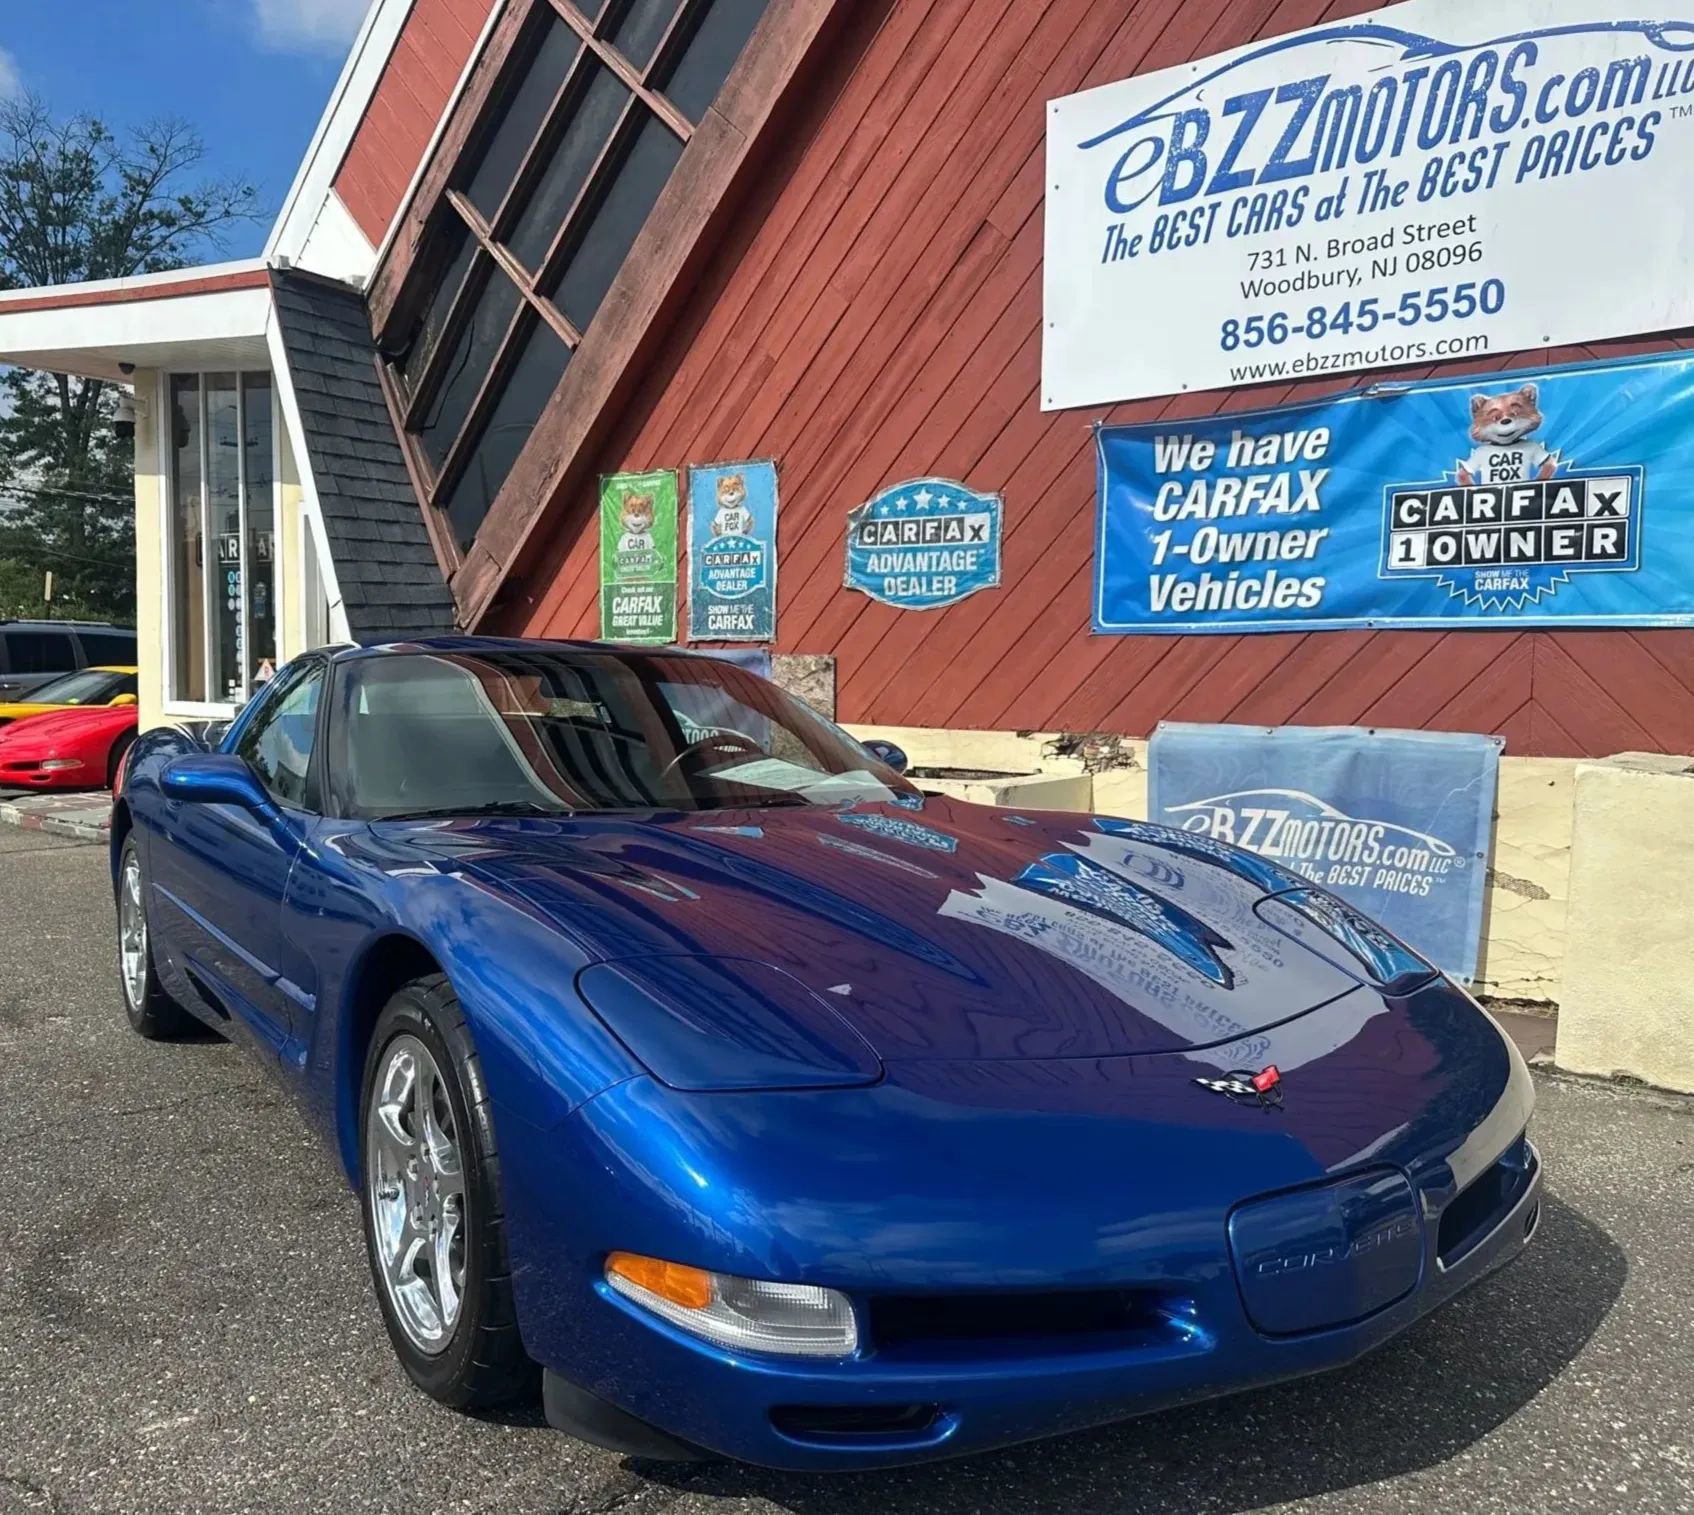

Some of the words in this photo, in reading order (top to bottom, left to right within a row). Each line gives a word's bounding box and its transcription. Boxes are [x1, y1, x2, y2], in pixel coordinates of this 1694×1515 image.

[1102, 223, 1142, 264] The
[1149, 202, 1221, 254] BEST
[1227, 185, 1309, 238] CARS
[1315, 177, 1349, 221] at
[1357, 167, 1409, 215] The
[1417, 141, 1510, 202] BEST
[1515, 111, 1661, 184] PRICES
[1247, 248, 1287, 271] 731
[1296, 244, 1318, 263] N.
[1328, 228, 1394, 258] Broad
[1403, 214, 1477, 244] Street
[1241, 268, 1363, 299] Woodbury,
[1372, 257, 1398, 279] NJ
[1406, 242, 1483, 272] 08096
[1220, 279, 1505, 351] 856-845-5550
[1155, 434, 1215, 473] We
[1226, 427, 1330, 468] have
[1489, 452, 1523, 467] CAR
[1490, 467, 1521, 482] FOX
[1153, 468, 1330, 522] CARFAX
[1399, 487, 1622, 524] CARFAX
[724, 512, 739, 521] CAR
[863, 520, 985, 543] CARFAX
[627, 538, 645, 549] CAR
[1152, 526, 1329, 565] 1-Owner
[705, 553, 759, 566] CARFAX
[867, 549, 977, 573] ADVANTAGE
[708, 568, 756, 580] ADVANTAGE
[1475, 570, 1500, 579] SHOW
[1475, 577, 1529, 591] CARFAX
[716, 580, 748, 592] DEALER
[884, 575, 957, 596] DEALER
[1150, 570, 1326, 612] Vehicles
[612, 596, 663, 614] CARFAX
[708, 604, 729, 614] SHOW
[708, 614, 754, 630] CARFAX
[1429, 856, 1452, 875] LLC
[1327, 865, 1371, 887] BEST
[1373, 869, 1432, 897] PRICES
